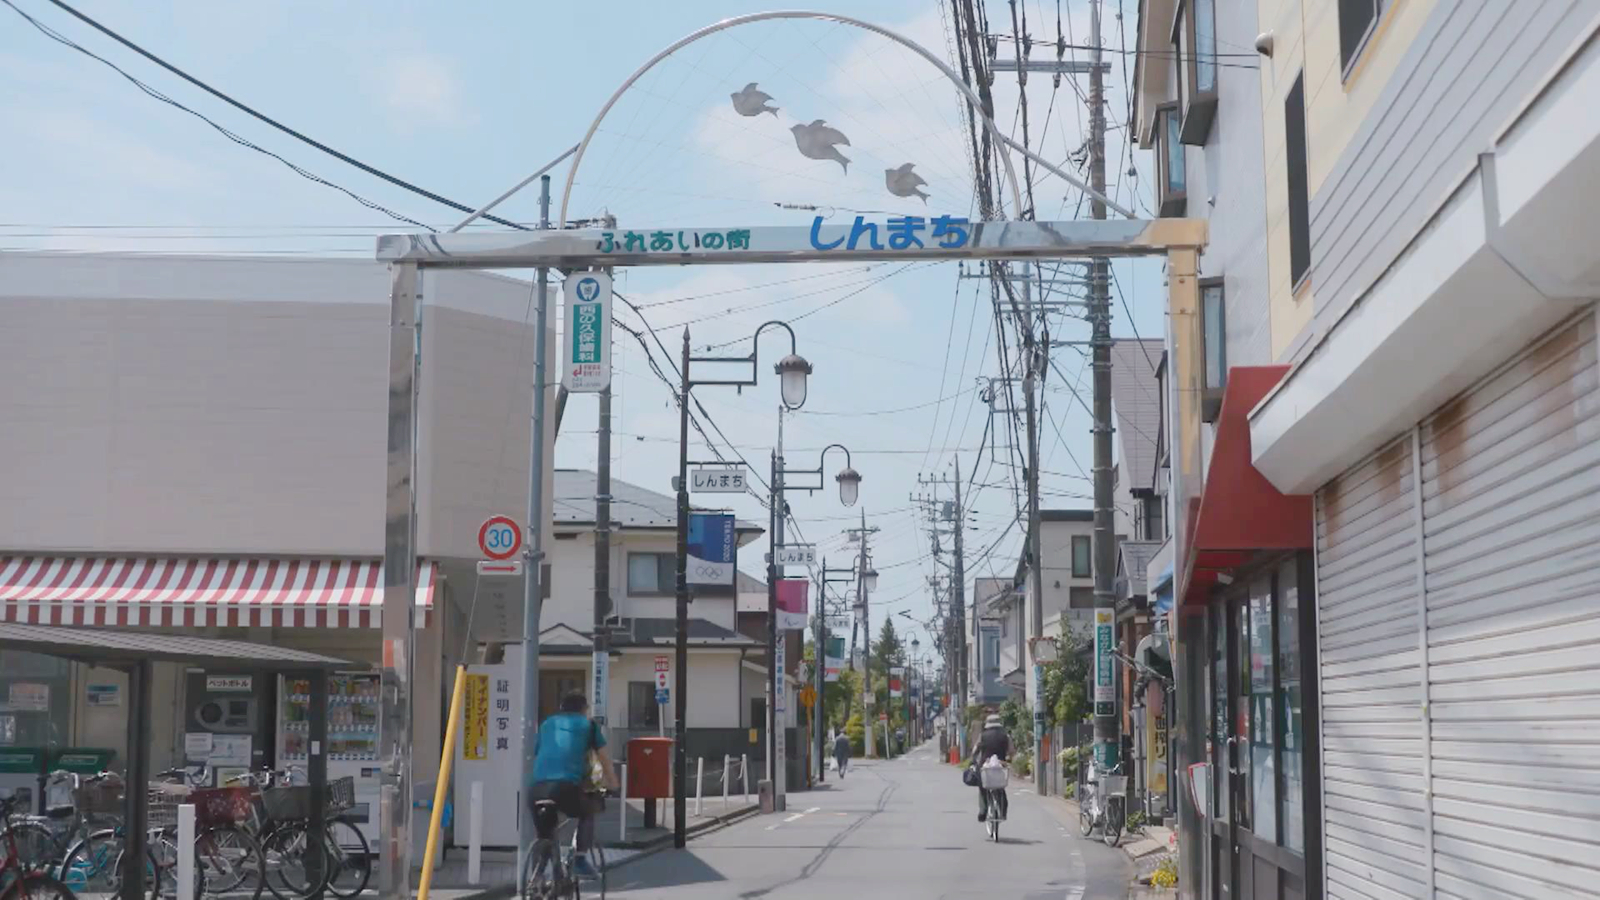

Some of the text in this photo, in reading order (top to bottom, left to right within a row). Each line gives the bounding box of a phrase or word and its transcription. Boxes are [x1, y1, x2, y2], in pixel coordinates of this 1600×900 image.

[598, 229, 750, 253] ふれあいの街
[812, 214, 968, 250] しんまち
[694, 475, 743, 487] しんまち
[488, 529, 512, 547] 30
[778, 553, 813, 562] しんまち
[208, 680, 249, 688] ペットボトル
[496, 680, 509, 749] 証明写真
